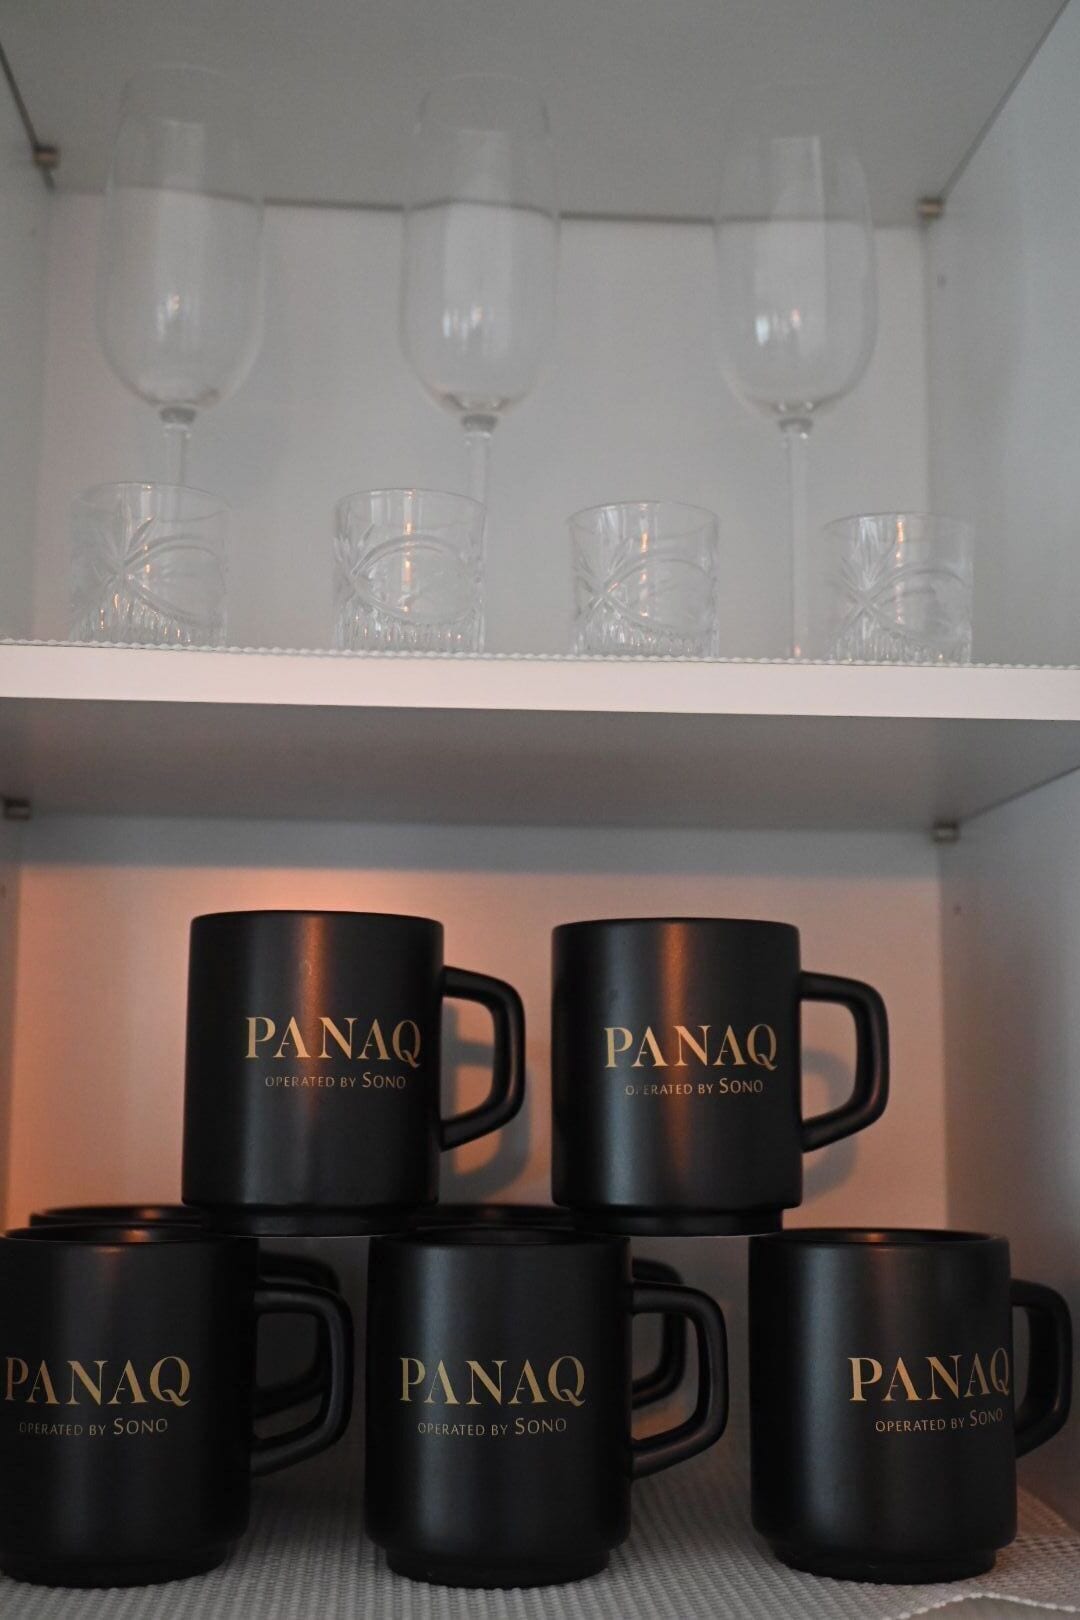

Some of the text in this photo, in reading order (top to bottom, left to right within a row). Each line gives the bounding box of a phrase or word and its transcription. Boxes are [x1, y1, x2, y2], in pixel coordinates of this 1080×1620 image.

[245, 1016, 421, 1068] PANAQ
[604, 1023, 777, 1071] PANAQ
[265, 1076, 335, 1088] OPERATED
[340, 1076, 356, 1088] BY
[625, 1083, 693, 1096] OERATED
[698, 1083, 713, 1095] BY
[5, 1356, 191, 1407] PANAQ
[400, 1355, 585, 1407] PANAQ
[848, 1347, 1010, 1401] PANAQ
[19, 1421, 84, 1436] OPERATED
[89, 1424, 106, 1436] BY
[417, 1422, 485, 1436] OPERATED
[491, 1424, 508, 1436] BY
[875, 1418, 946, 1432] OPERATED
[951, 1416, 964, 1429] BY
